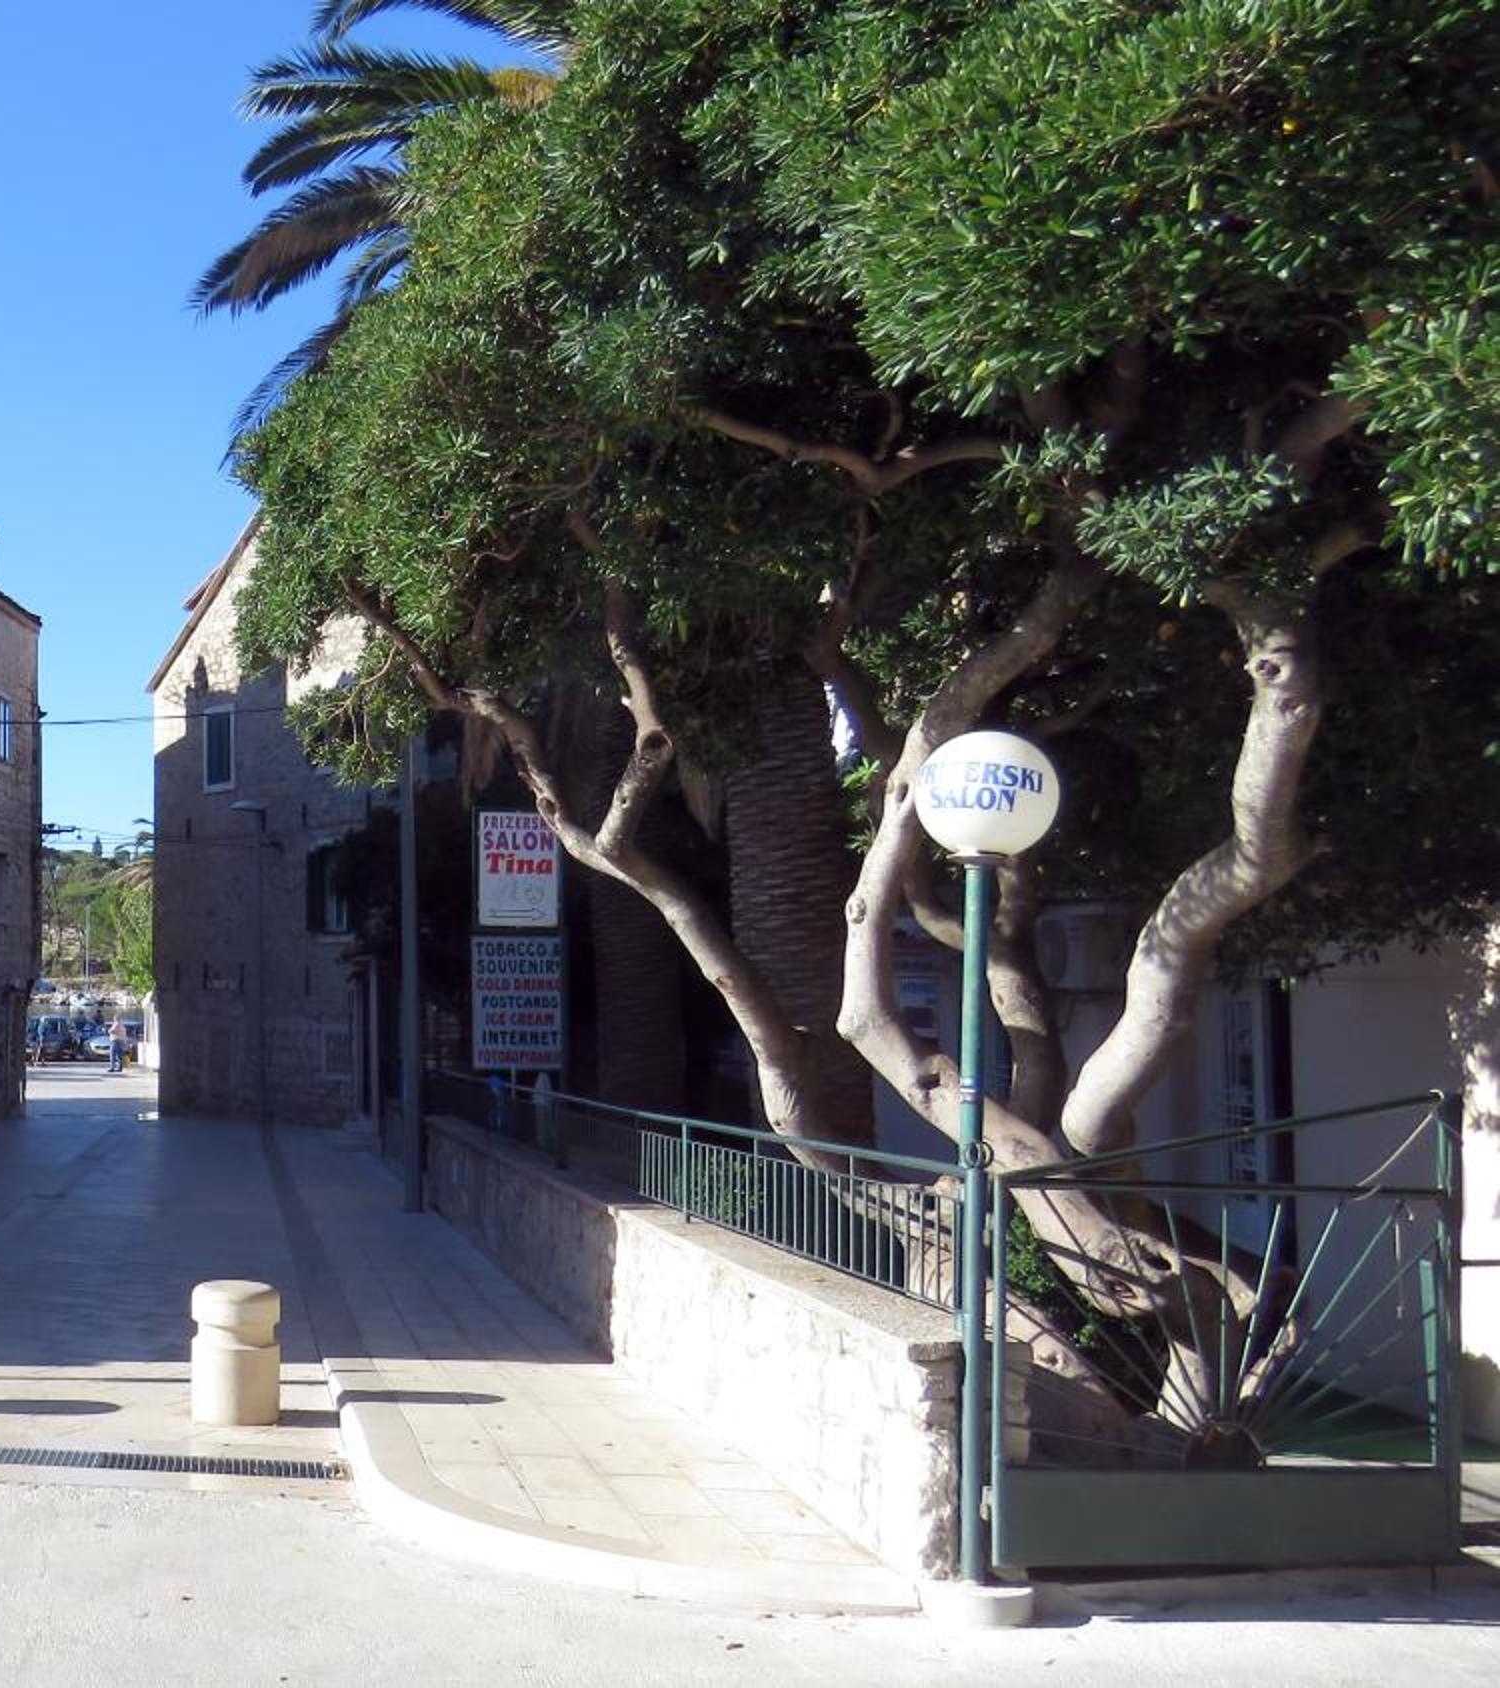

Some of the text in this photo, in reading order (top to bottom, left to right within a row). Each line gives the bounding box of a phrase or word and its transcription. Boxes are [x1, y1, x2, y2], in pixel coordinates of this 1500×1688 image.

[930, 786, 1018, 813] SALON
[483, 815, 551, 831] FRIZERSK
[483, 832, 555, 851] SALON
[486, 853, 554, 875] Tina
[475, 941, 548, 957] TOBACCO
[476, 977, 511, 991] COLD
[481, 995, 559, 1009] POSTCARDS
[485, 1012, 555, 1025] ICE CREAM
[482, 1030, 558, 1046] INTERNET
